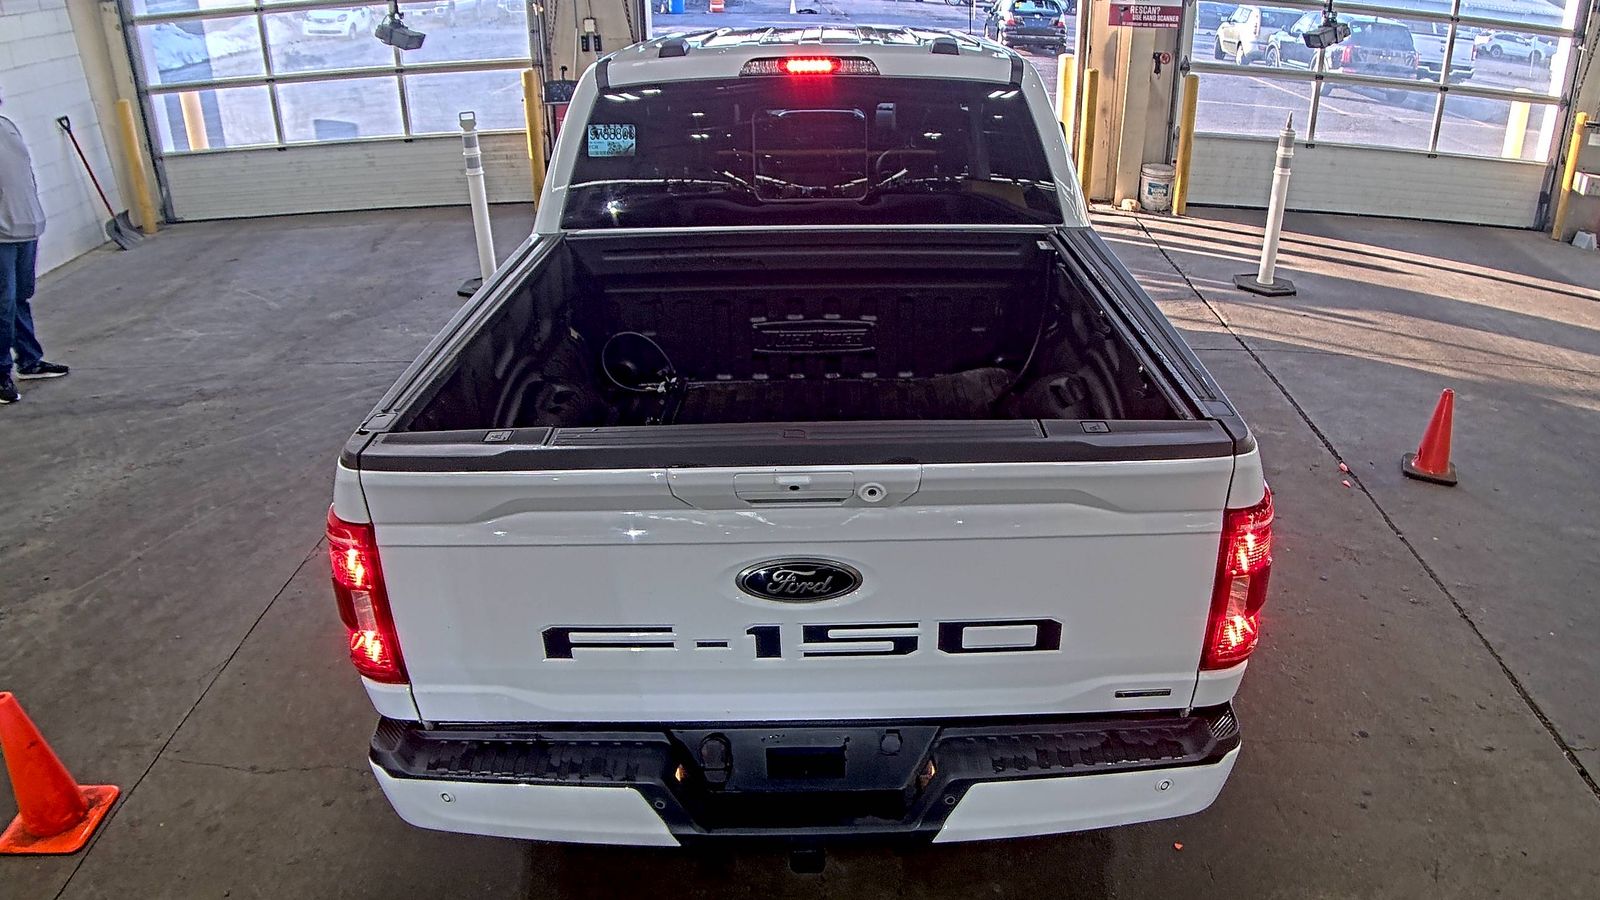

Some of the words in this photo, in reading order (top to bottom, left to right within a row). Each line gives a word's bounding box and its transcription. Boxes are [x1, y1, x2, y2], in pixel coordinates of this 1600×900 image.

[1130, 5, 1161, 14] RESCAN?
[766, 569, 833, 594] Ford
[541, 619, 1062, 660] F-150
